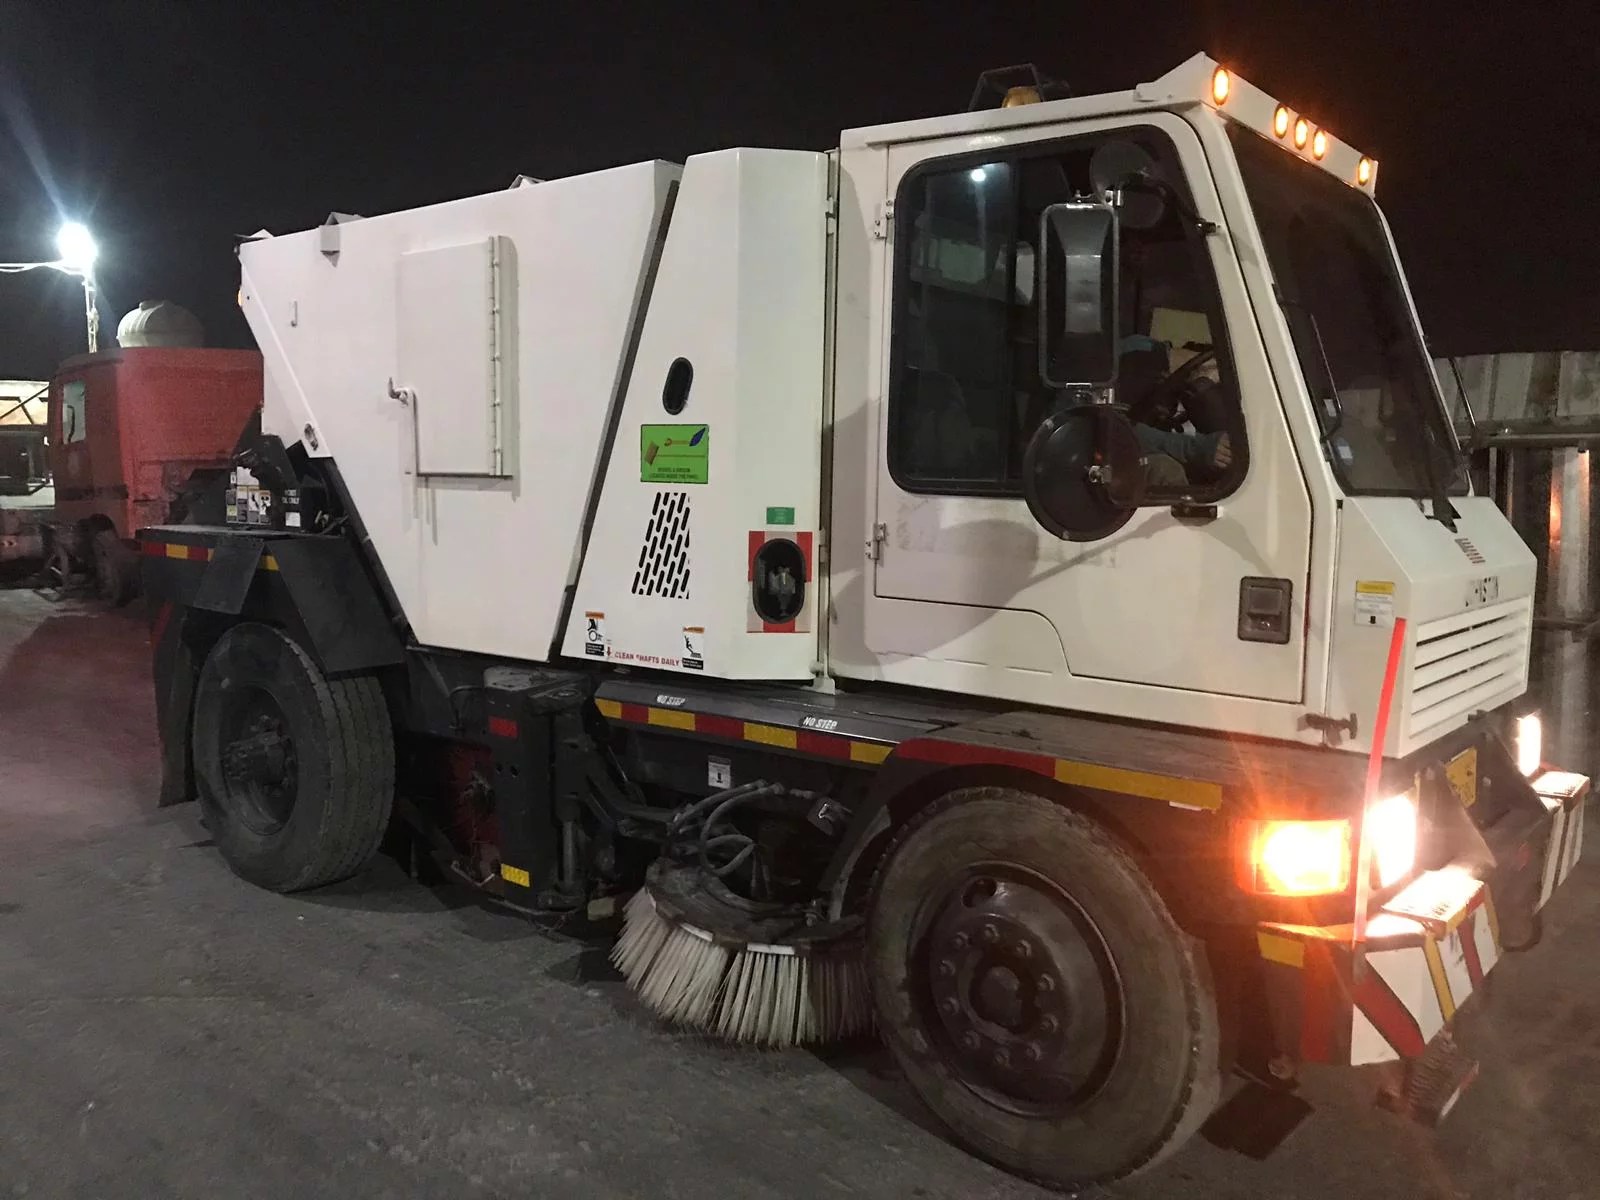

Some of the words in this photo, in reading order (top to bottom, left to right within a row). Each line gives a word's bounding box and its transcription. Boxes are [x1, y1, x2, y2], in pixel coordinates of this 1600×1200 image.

[614, 651, 634, 660] CLEAN
[661, 657, 680, 667] DAILY
[656, 694, 667, 704] NO
[667, 696, 686, 706] STEP
[802, 716, 816, 726] NO
[815, 718, 838, 729] STEP
